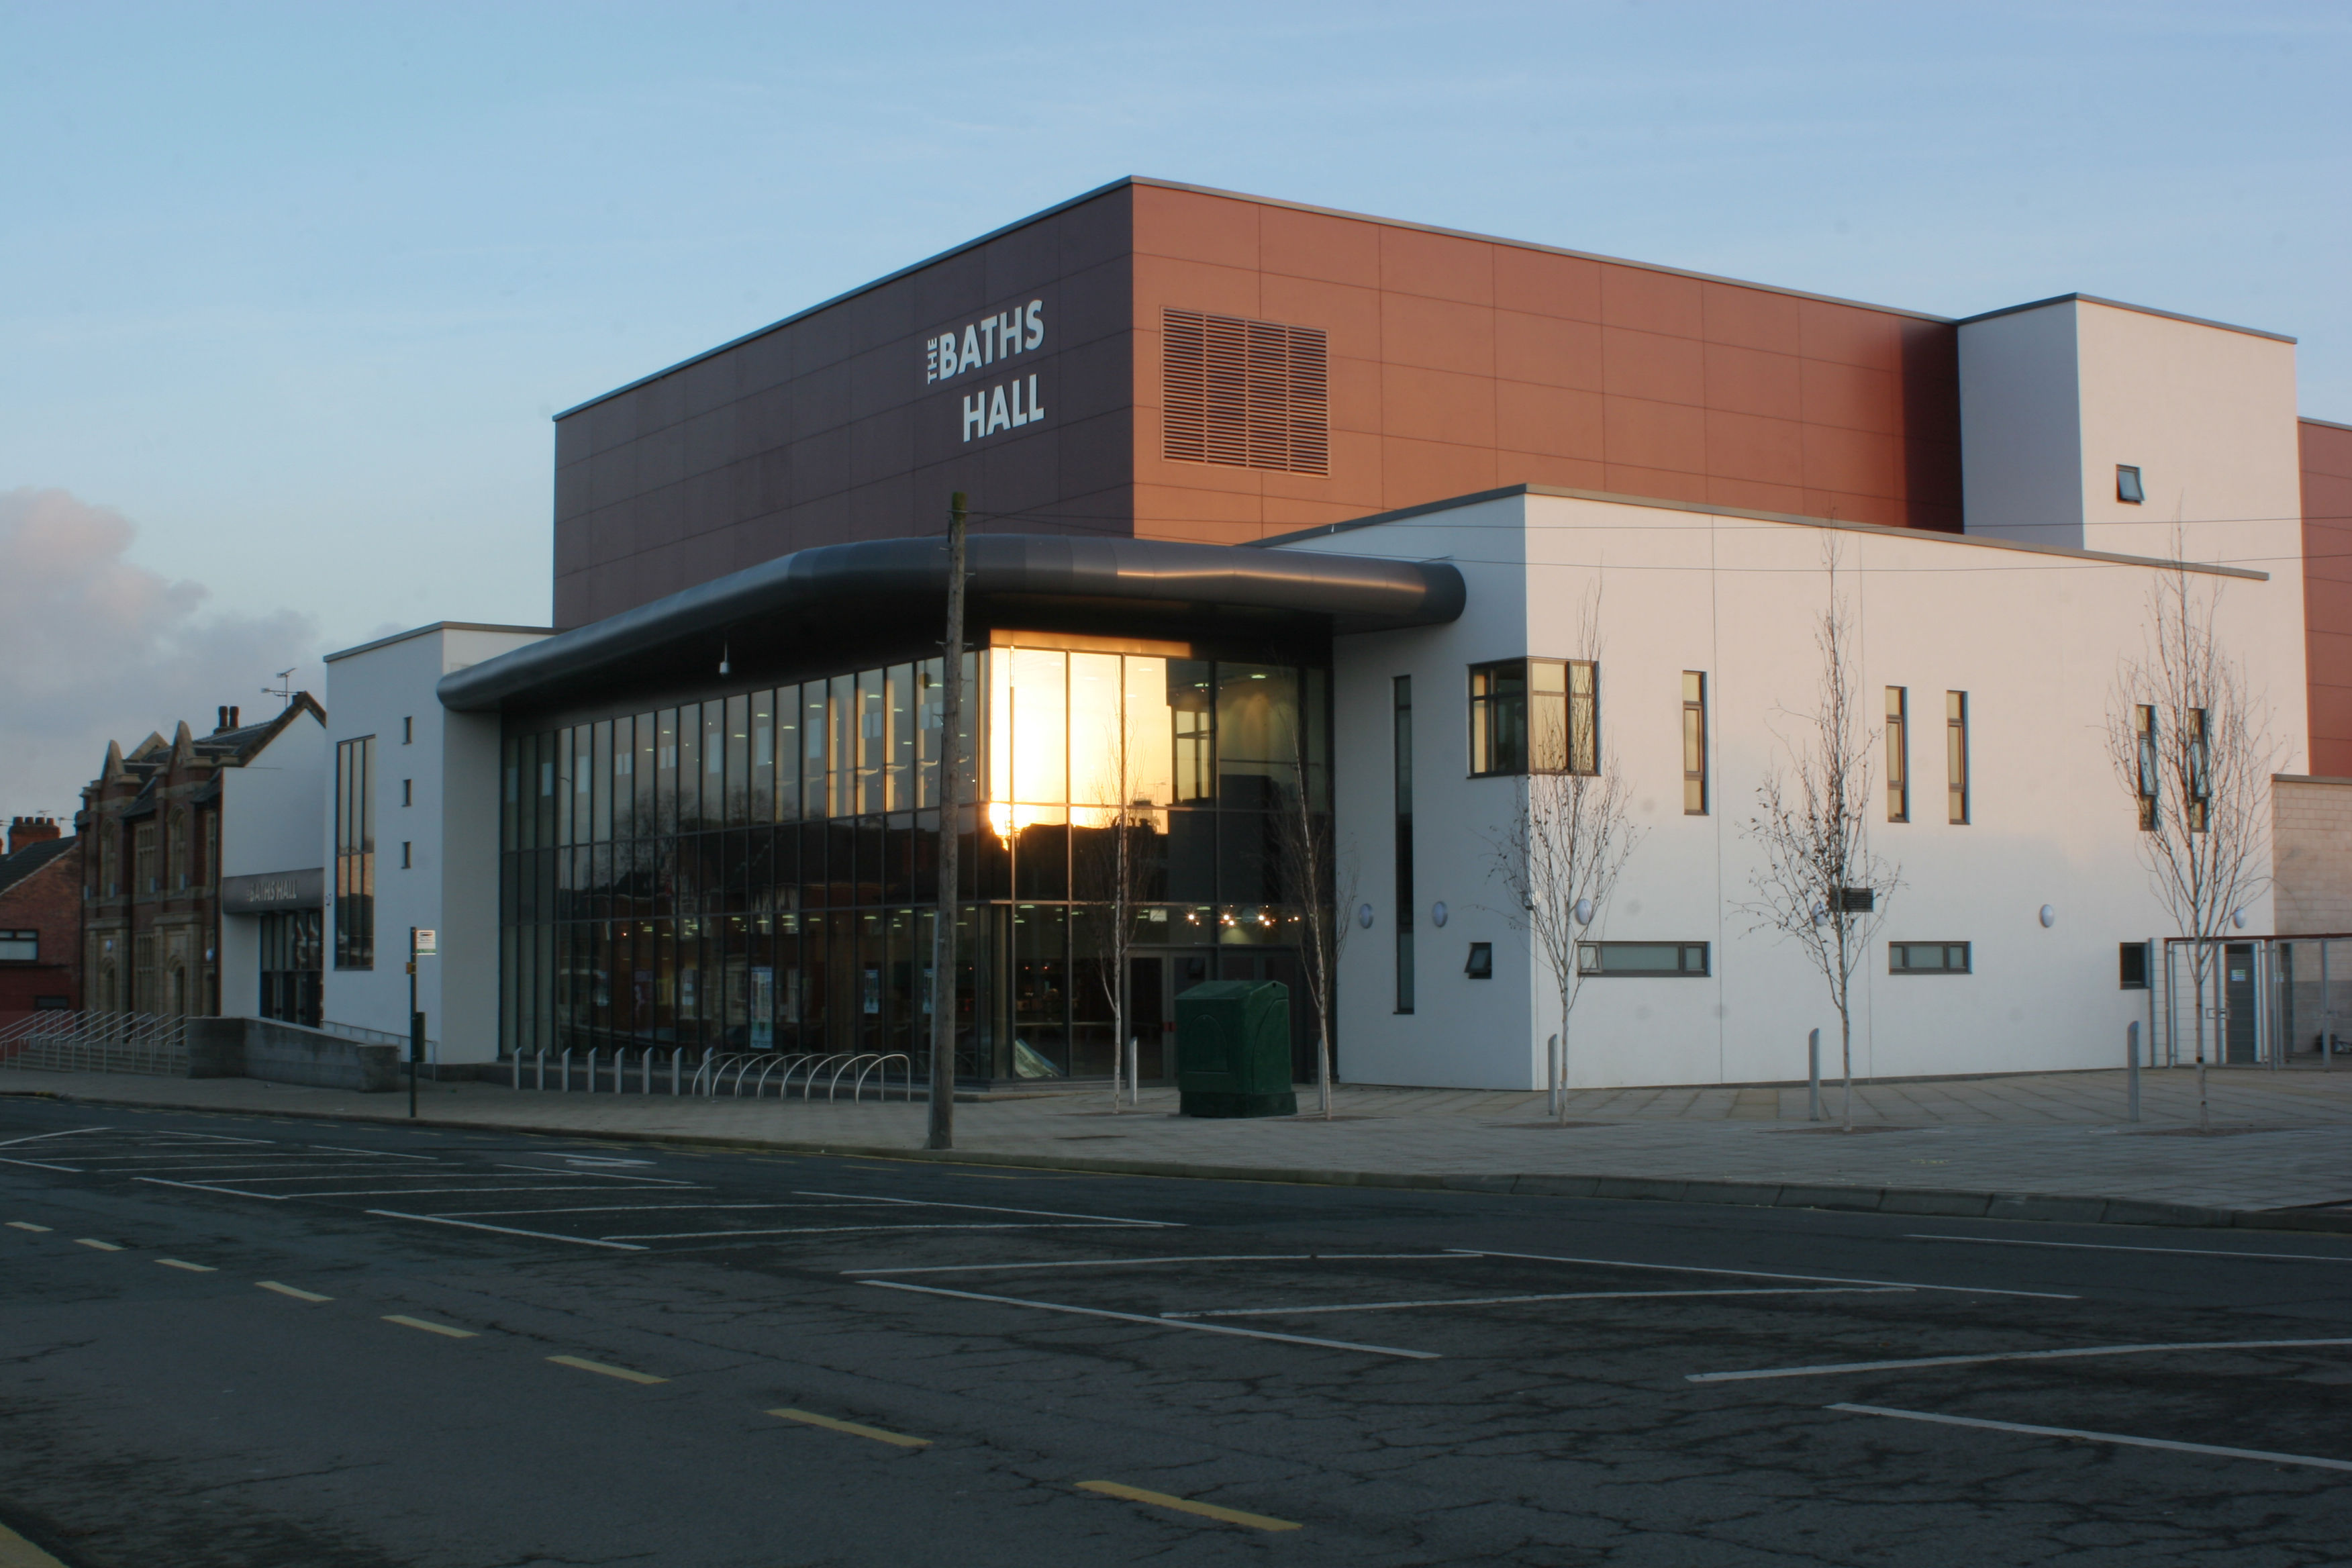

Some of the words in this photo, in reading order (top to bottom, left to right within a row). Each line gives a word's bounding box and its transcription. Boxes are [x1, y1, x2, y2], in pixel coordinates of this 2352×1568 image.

[928, 338, 938, 385] THE
[940, 299, 1044, 380] BATHS
[963, 374, 1044, 442] HALL
[250, 881, 276, 902] BATHS
[275, 879, 297, 900] HALL
